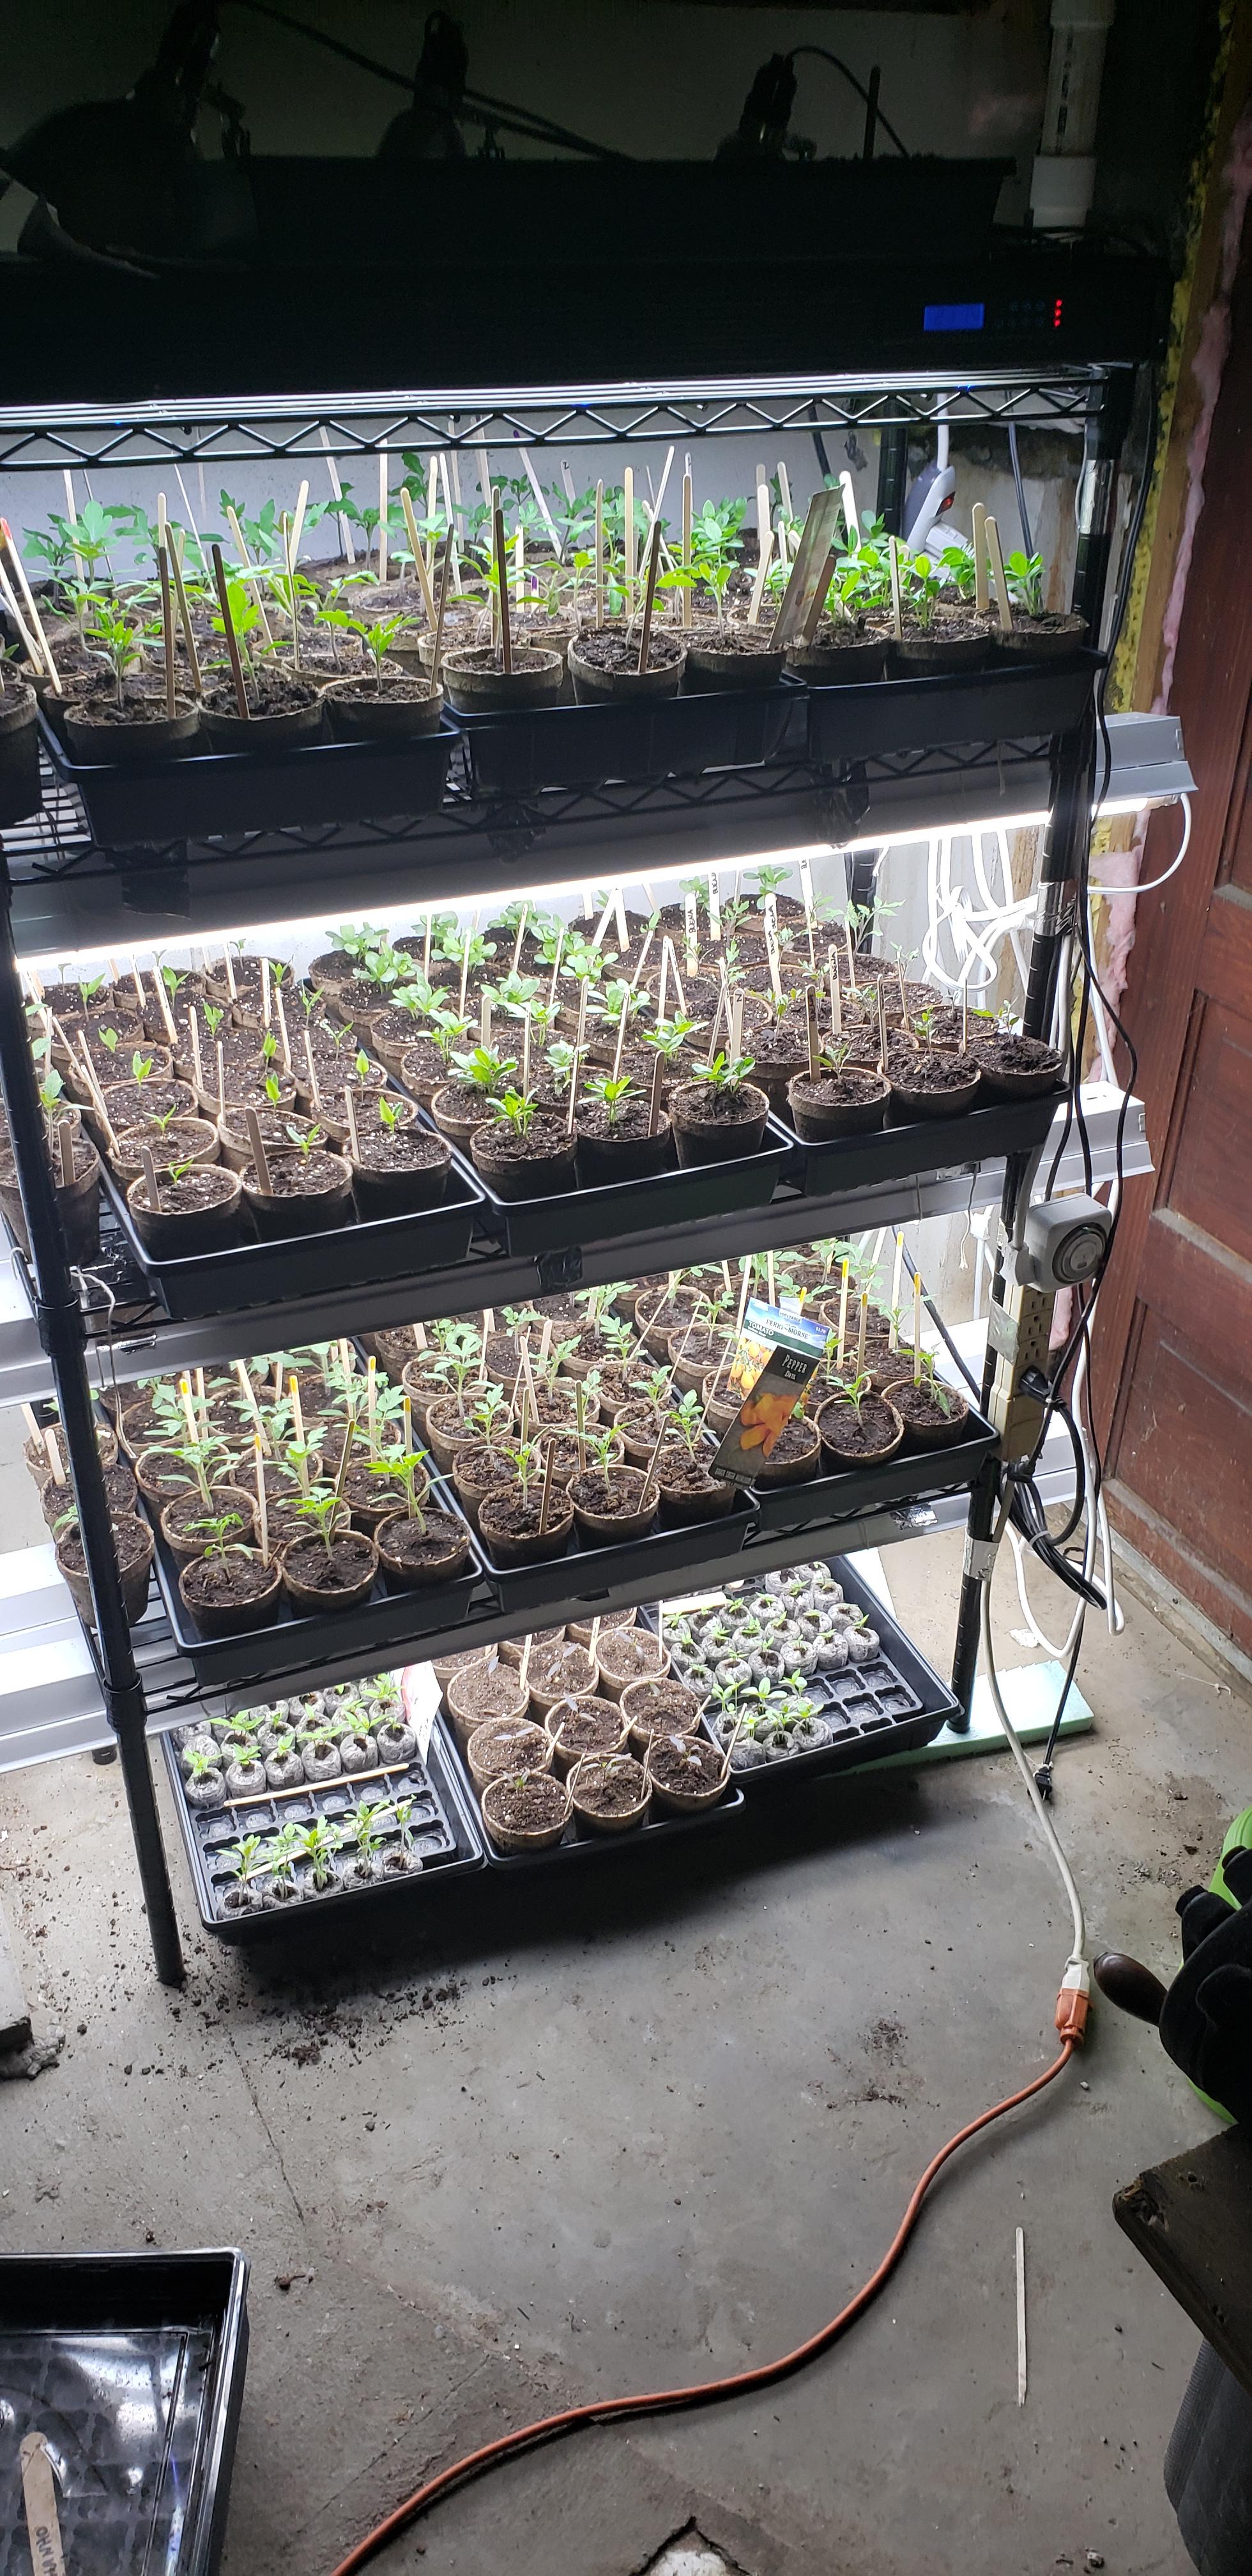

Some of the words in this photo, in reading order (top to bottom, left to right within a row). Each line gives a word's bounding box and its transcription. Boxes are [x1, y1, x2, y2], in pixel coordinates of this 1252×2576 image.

[687, 909, 696, 933] BUENA
[735, 993, 742, 1002] Z
[749, 1321, 774, 1336] TOMATO
[781, 1354, 807, 1374] PEPPER
